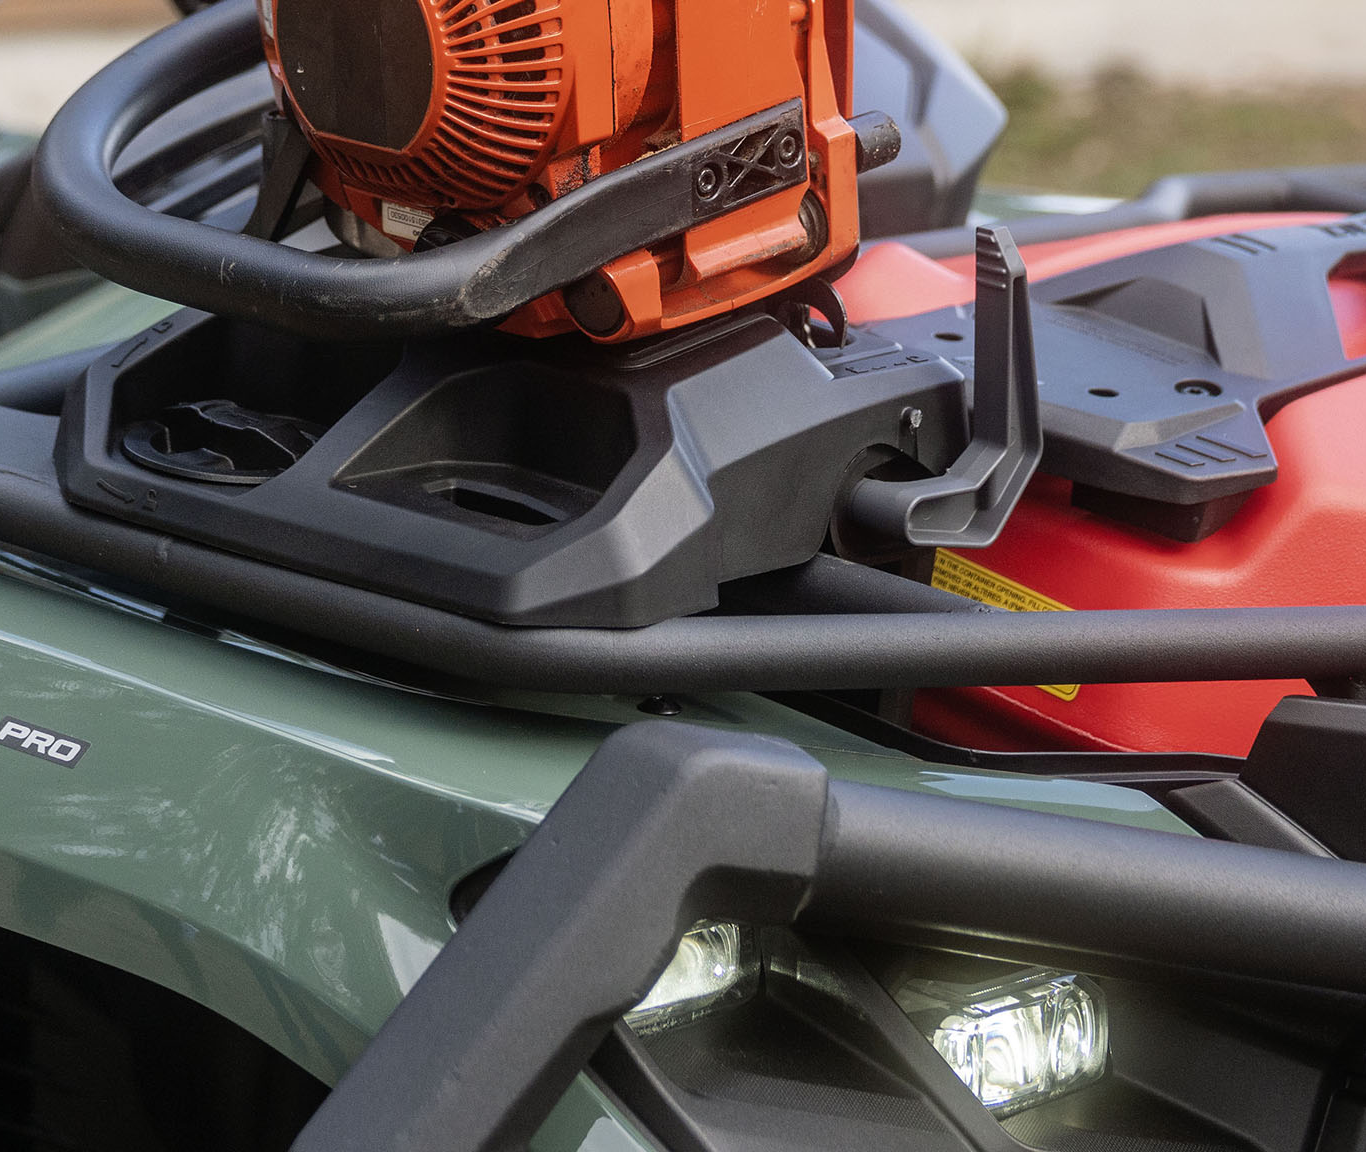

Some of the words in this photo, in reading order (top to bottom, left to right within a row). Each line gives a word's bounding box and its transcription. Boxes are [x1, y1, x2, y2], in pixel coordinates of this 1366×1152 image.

[946, 560, 959, 572] THE
[959, 566, 996, 589] CONTAINER
[949, 583, 971, 598] NEVER
[962, 579, 973, 589] OR
